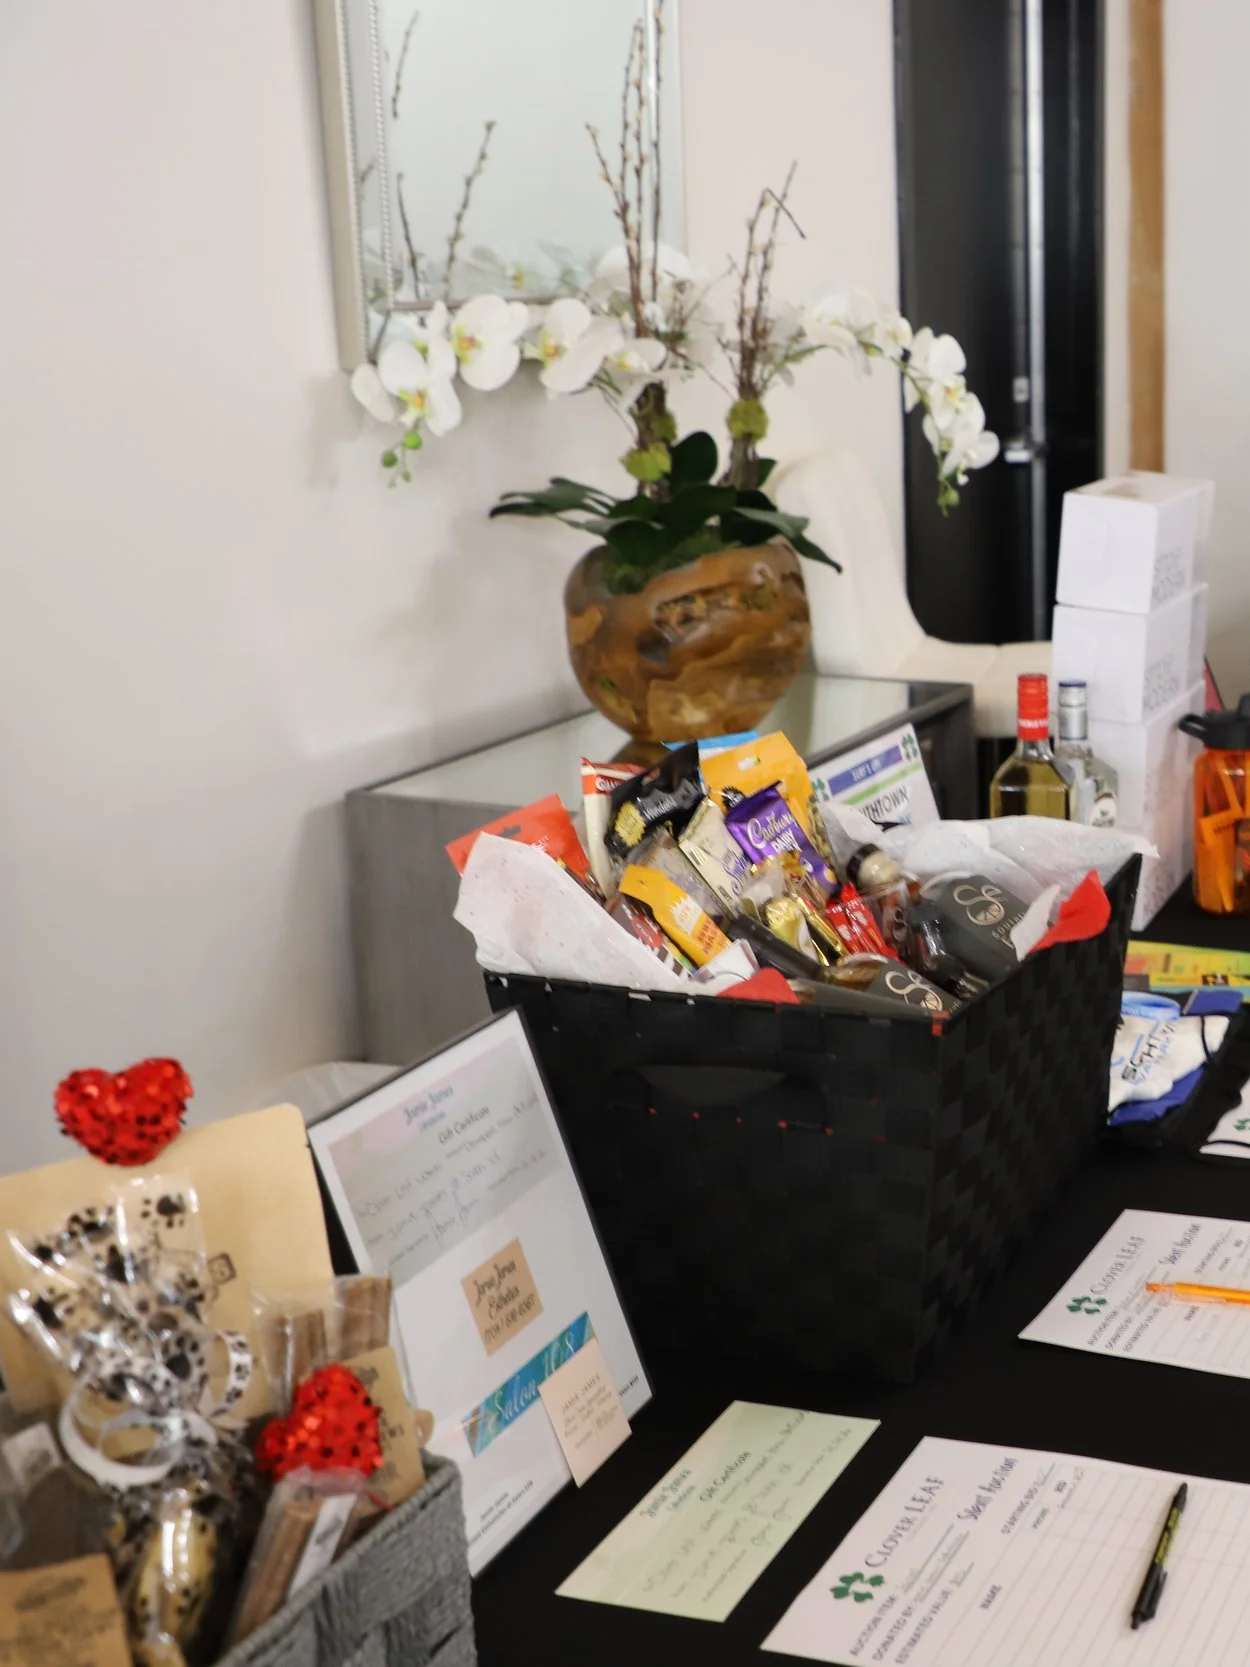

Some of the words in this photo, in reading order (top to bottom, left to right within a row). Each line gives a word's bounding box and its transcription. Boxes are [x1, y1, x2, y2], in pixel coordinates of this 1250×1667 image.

[747, 811, 799, 849] Cadbury
[770, 828, 803, 854] DAIRY
[453, 1106, 490, 1135] Certificate
[487, 1379, 539, 1429] Salon
[956, 1494, 987, 1521] Silent
[977, 1457, 1017, 1494] Auction
[863, 1516, 914, 1569] CLOVER
[903, 1476, 944, 1513] LEAF
[1000, 1500, 1030, 1534] STARTING
[980, 1584, 1002, 1609] NAME
[849, 1616, 882, 1657] AUCTION
[871, 1618, 907, 1660] DONATED
[894, 1616, 934, 1664] ESTIMATED
